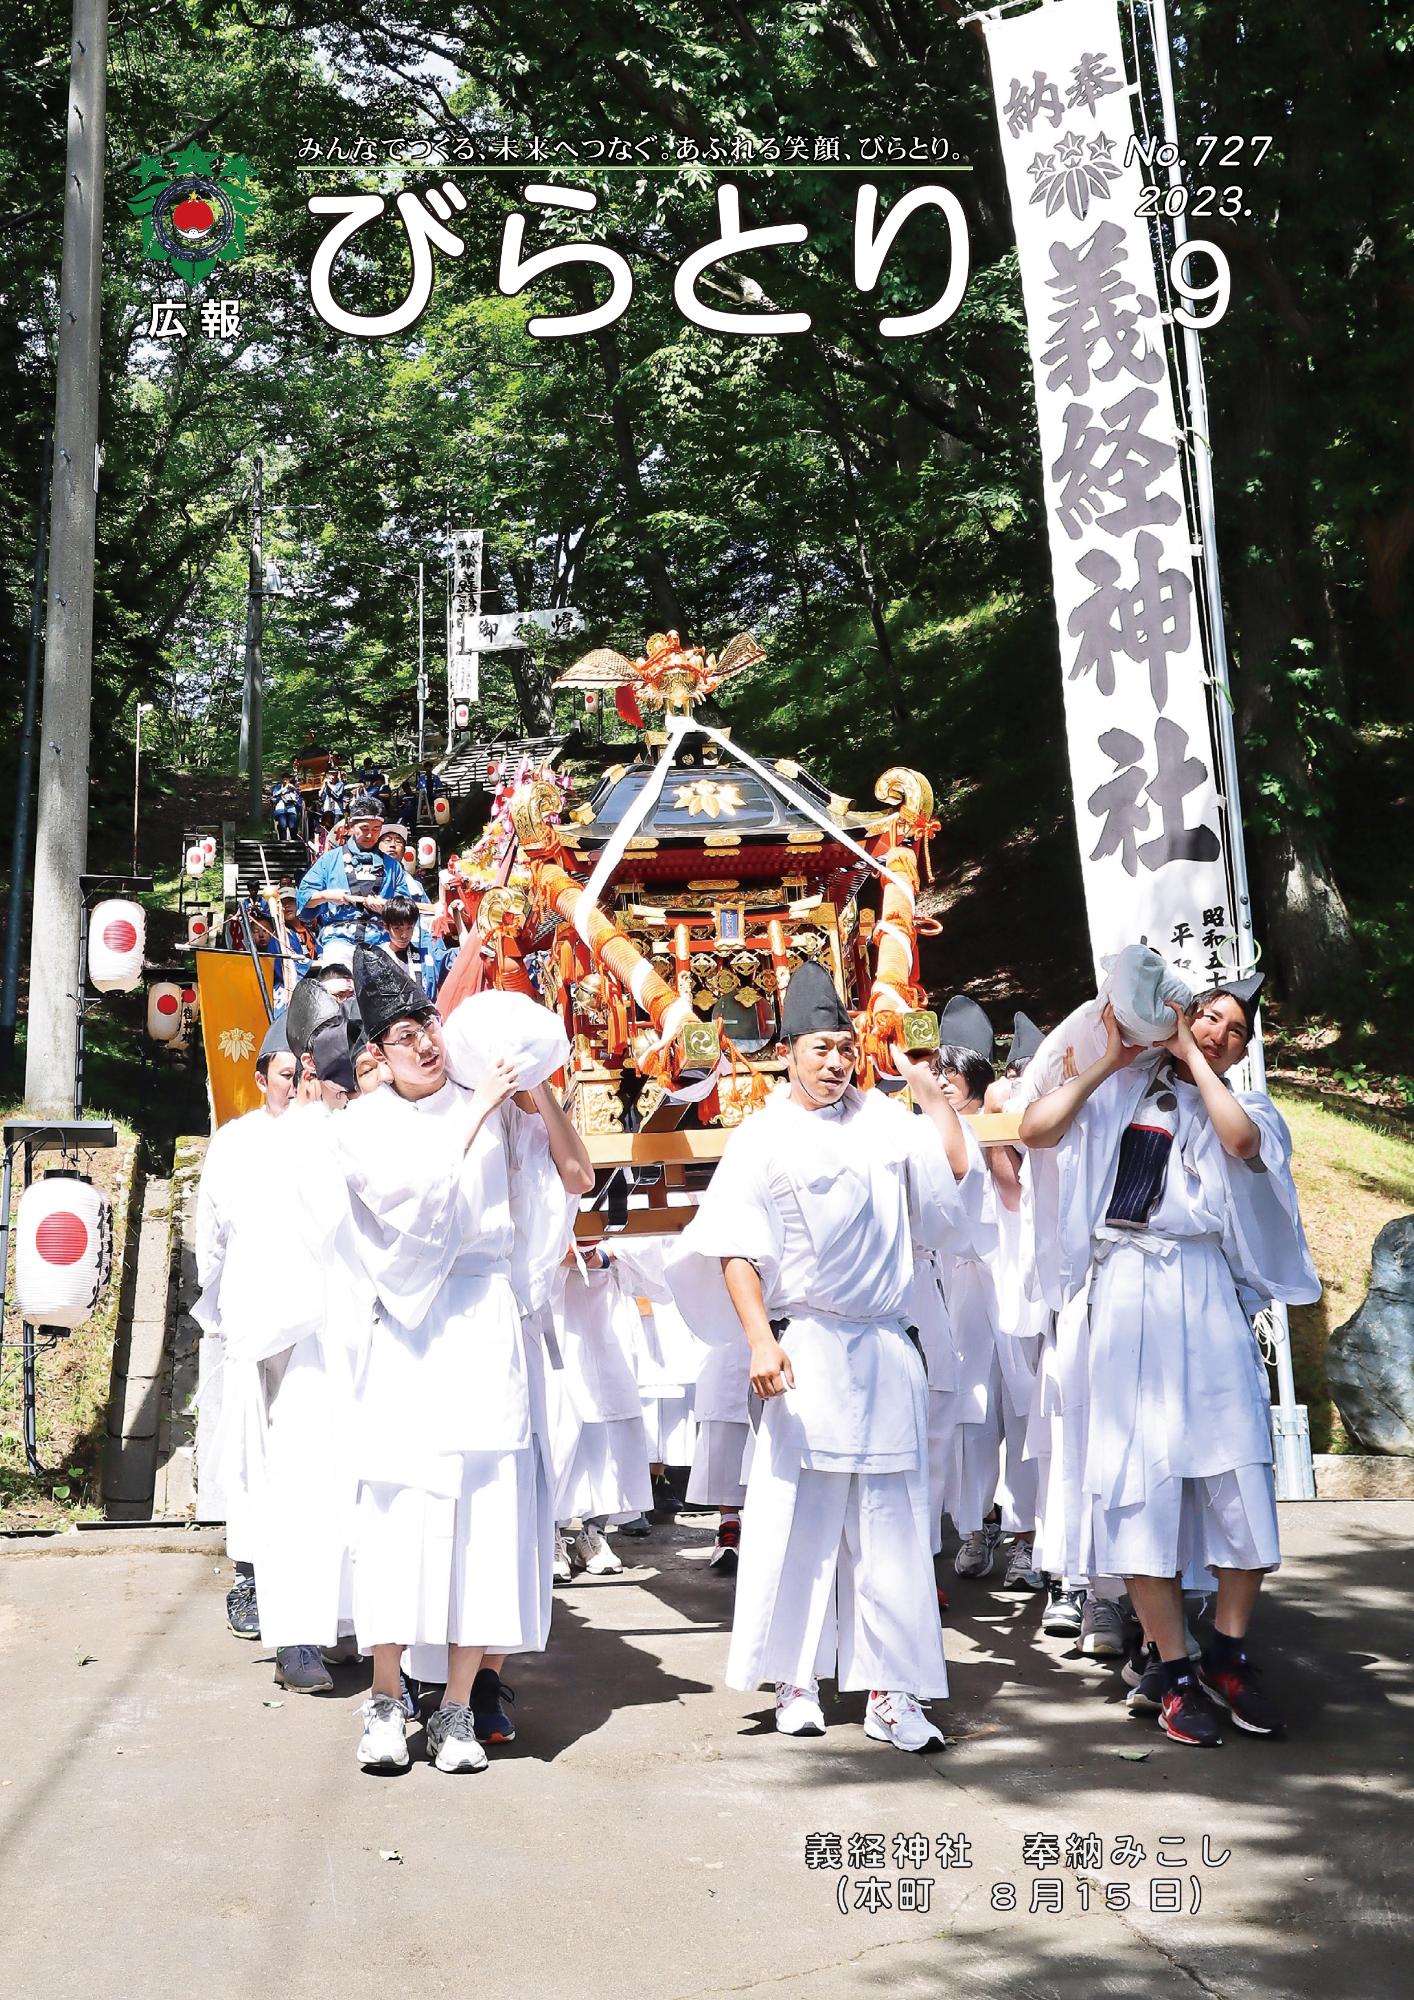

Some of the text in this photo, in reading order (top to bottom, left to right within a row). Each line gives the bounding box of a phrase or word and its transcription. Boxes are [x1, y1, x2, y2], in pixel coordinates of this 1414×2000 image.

[1040, 219, 1221, 879] 義経神社
[1203, 906, 1227, 988] 昭和五十
